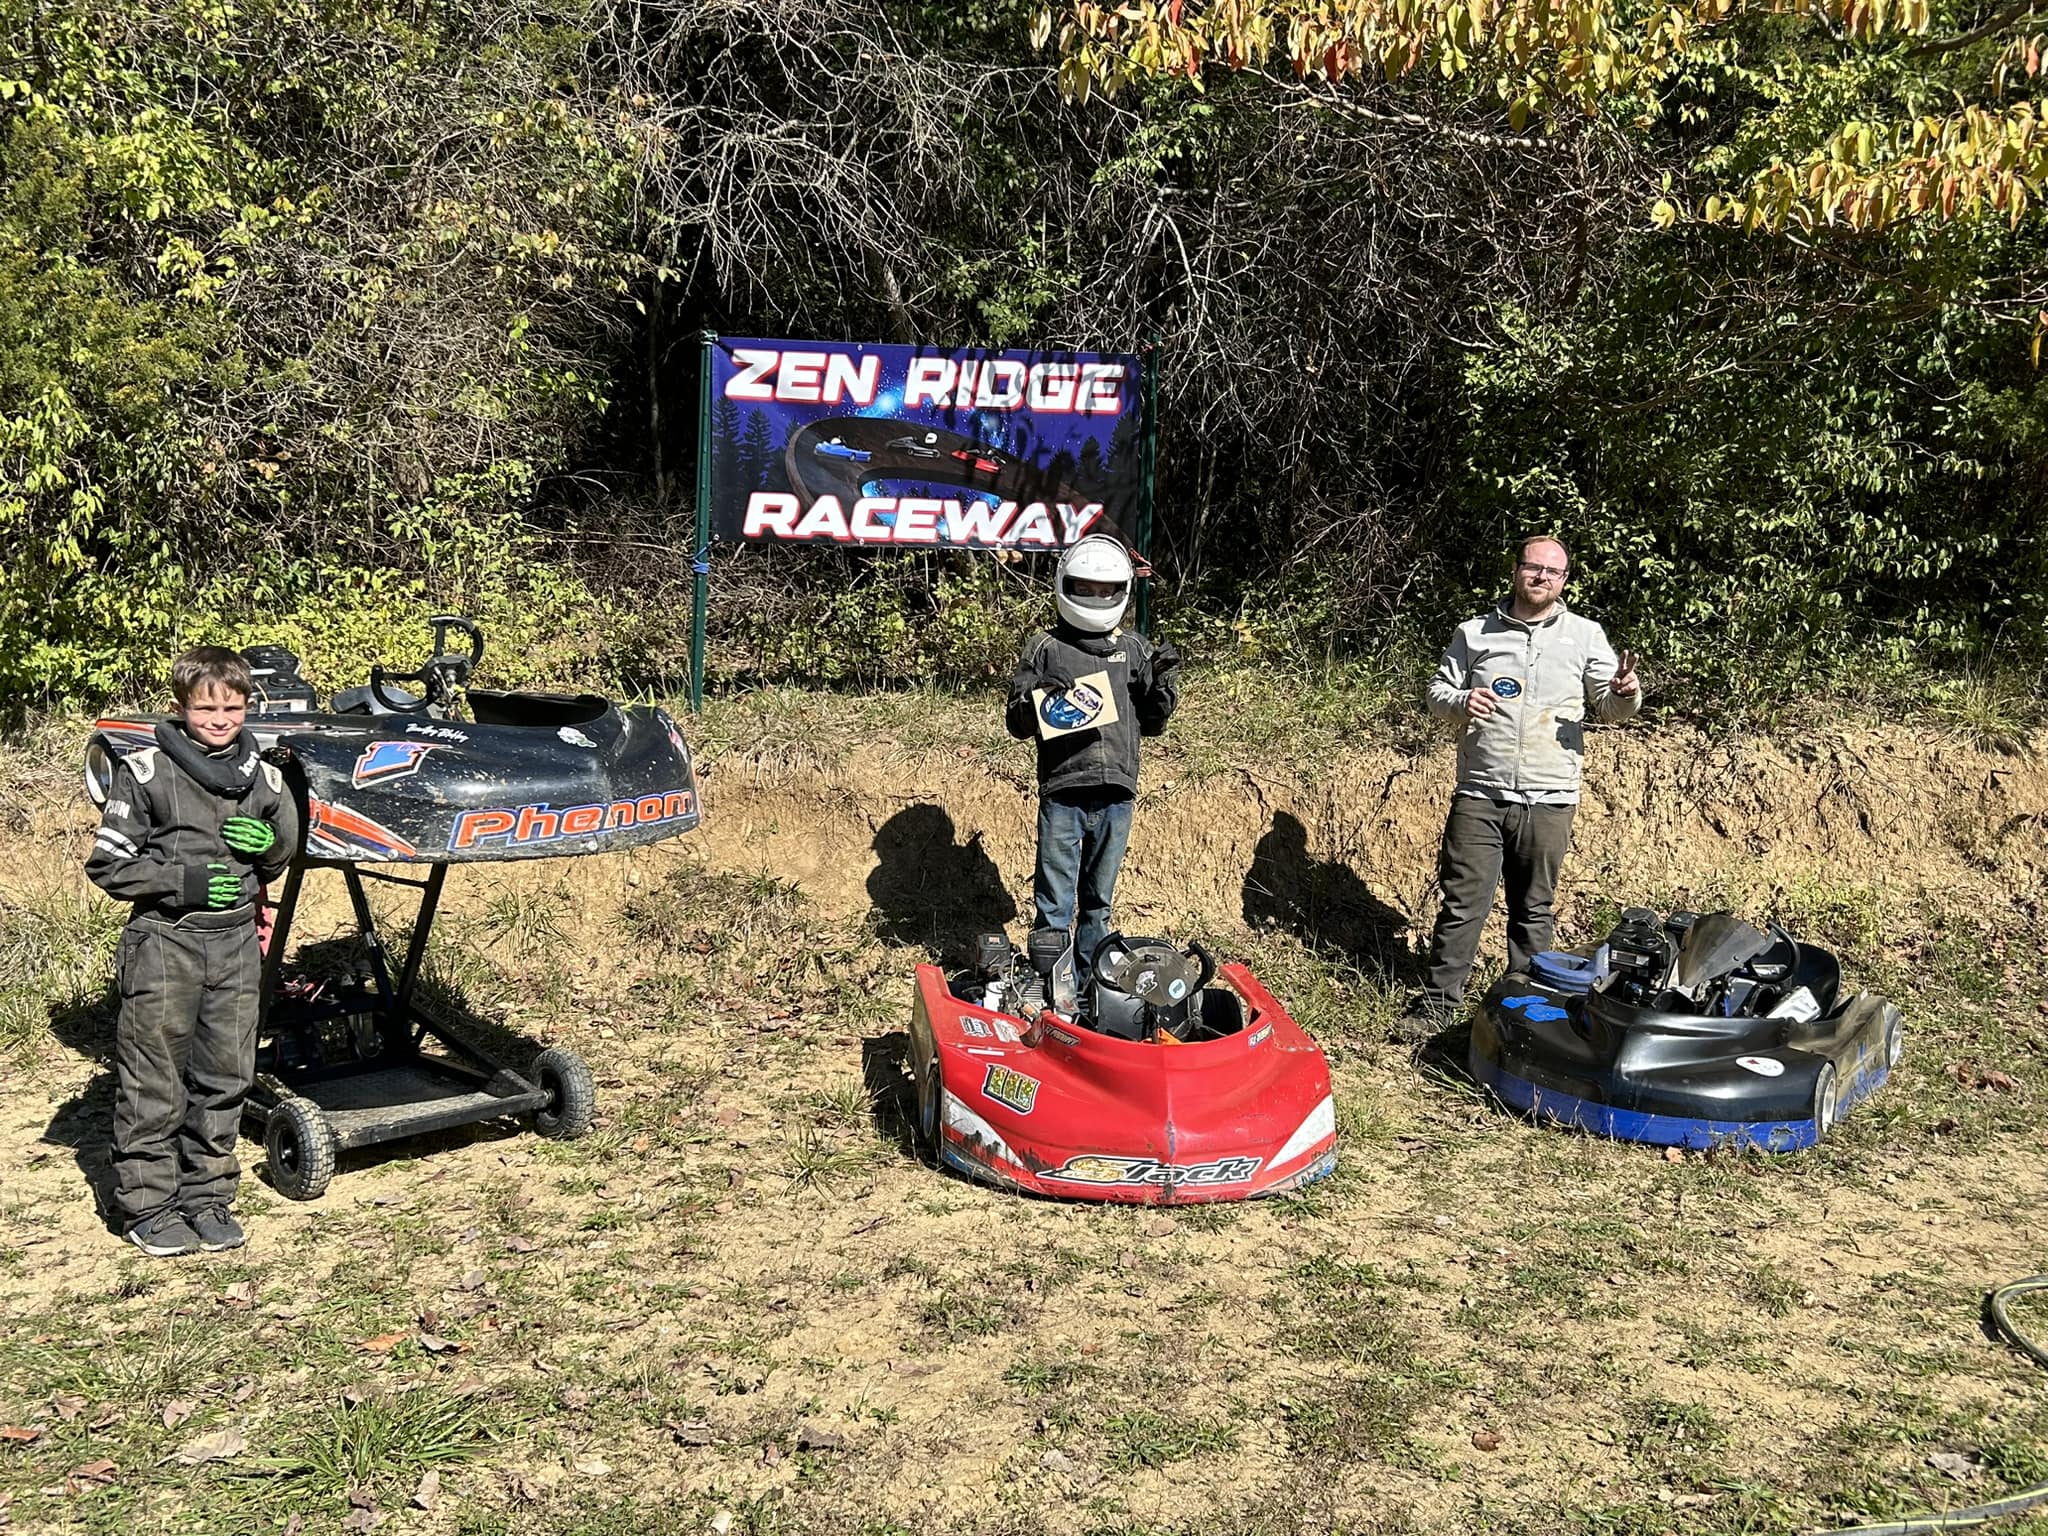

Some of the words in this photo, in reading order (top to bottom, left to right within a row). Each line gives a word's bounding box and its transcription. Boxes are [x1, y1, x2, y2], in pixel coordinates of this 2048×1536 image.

[726, 349, 880, 404] ZEN
[904, 356, 1126, 415] RIDGE
[743, 492, 1104, 546] RACEWAY
[448, 789, 697, 850] Phenom
